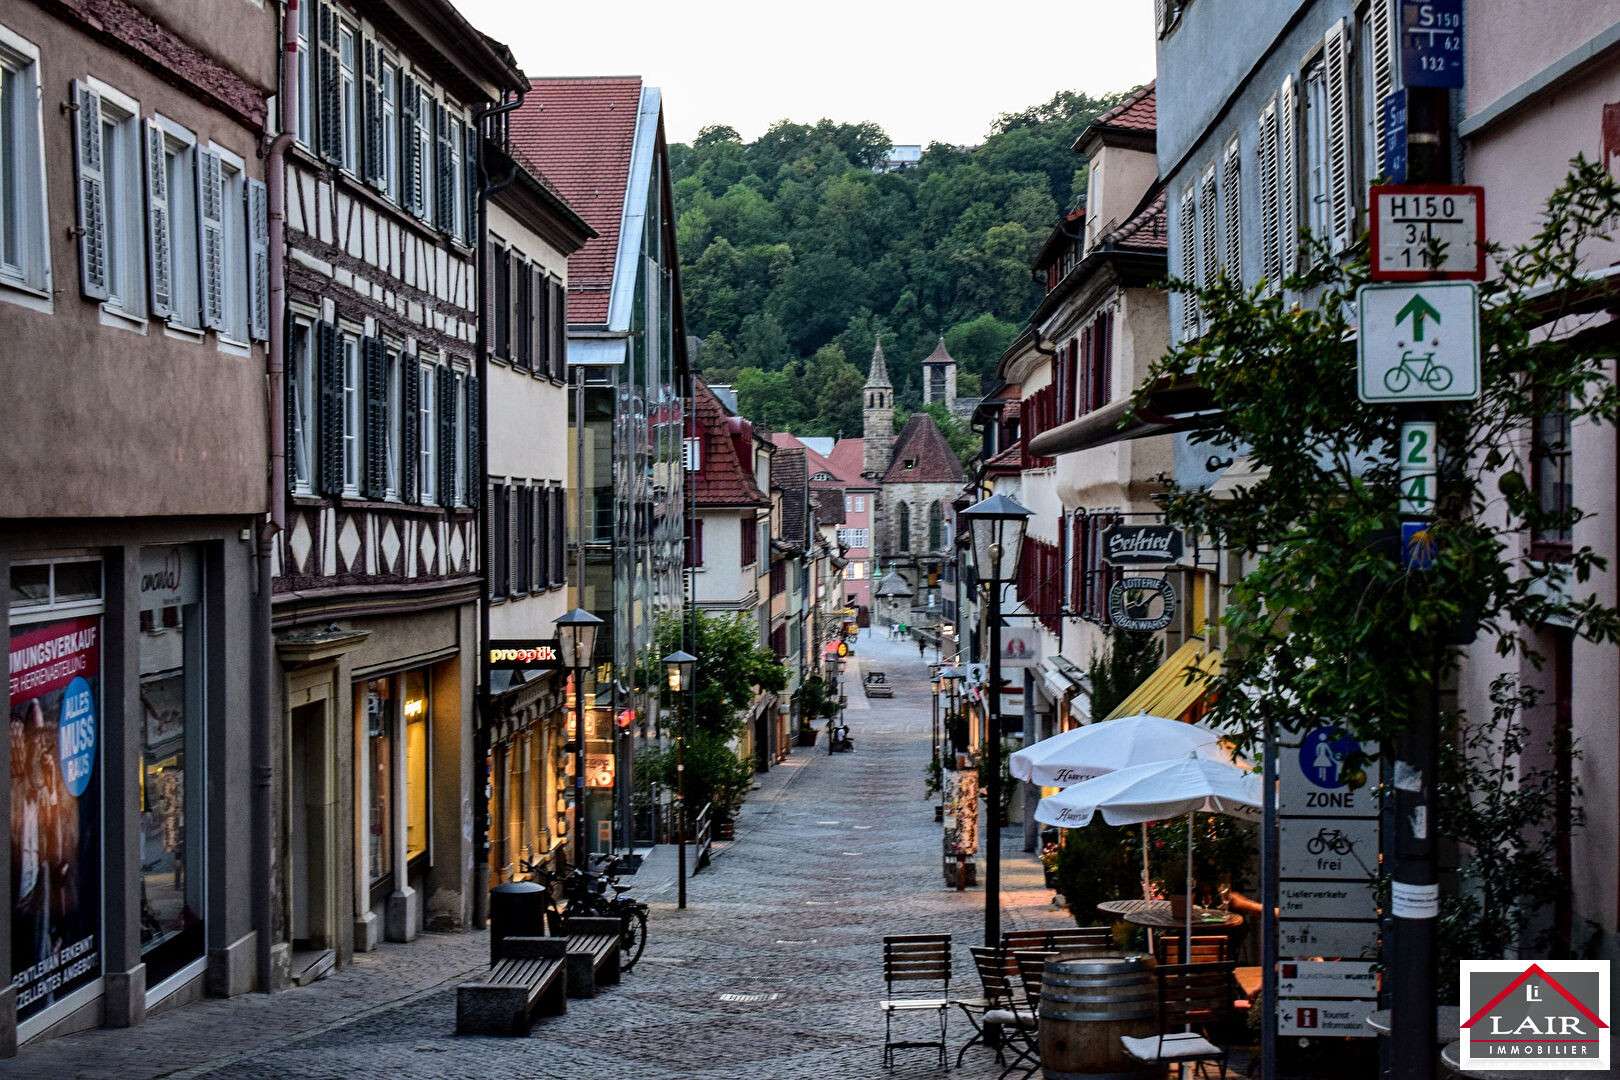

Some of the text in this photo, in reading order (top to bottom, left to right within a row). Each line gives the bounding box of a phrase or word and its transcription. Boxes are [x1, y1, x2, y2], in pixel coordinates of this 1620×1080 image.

[1408, 430, 1427, 463] 2
[1408, 475, 1427, 508] 4
[1109, 528, 1174, 557] Seifried
[65, 690, 90, 721] ALLES
[61, 714, 95, 760] MUSS
[1306, 792, 1354, 808] ZONE
[1317, 858, 1341, 871] frei
